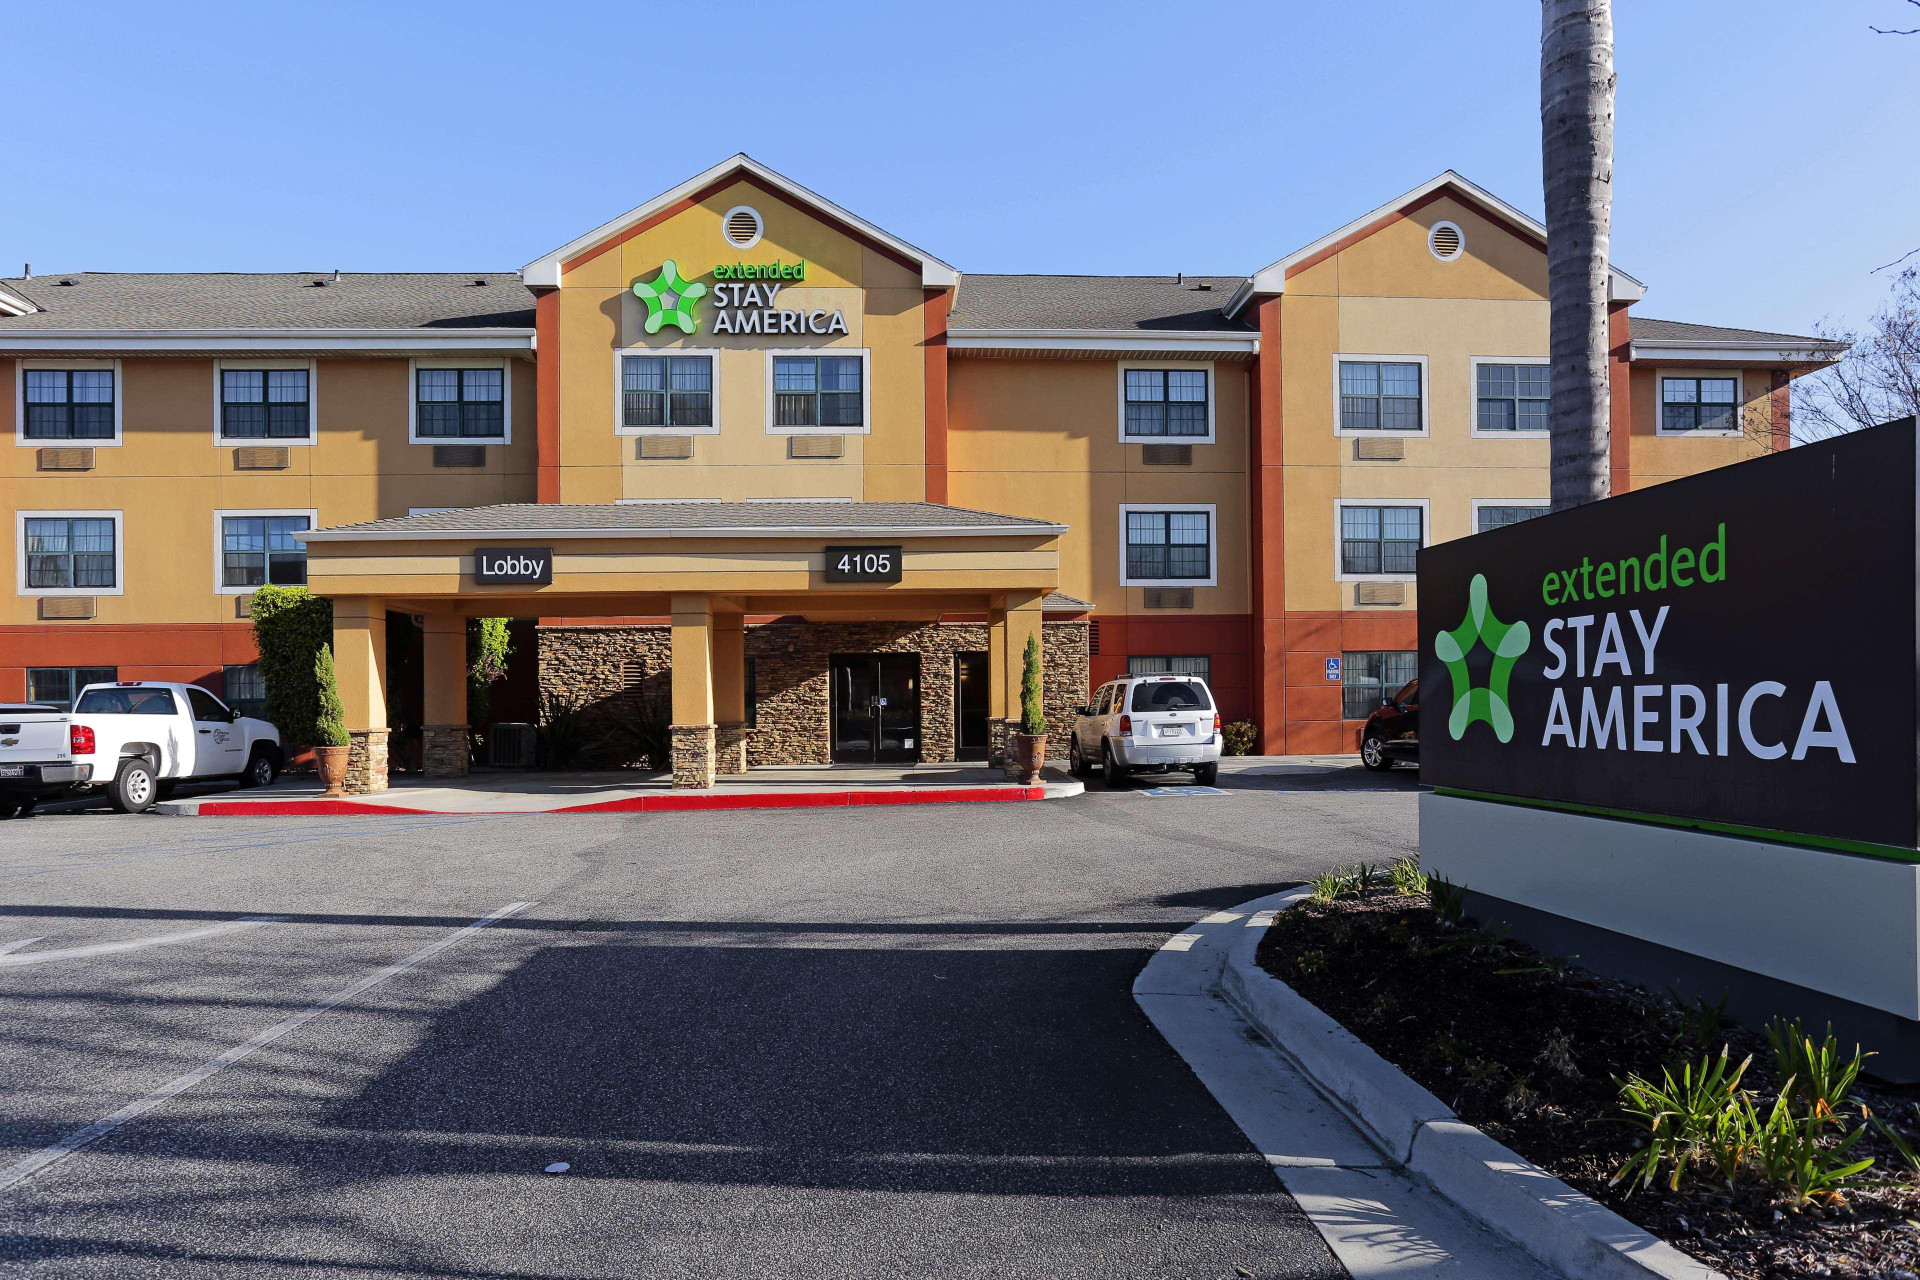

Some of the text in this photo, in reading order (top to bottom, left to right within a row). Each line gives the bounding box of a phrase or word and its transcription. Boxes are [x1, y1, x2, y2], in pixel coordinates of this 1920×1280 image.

[713, 259, 805, 280] extended
[713, 283, 782, 307] STAY
[712, 309, 849, 334] AMERICA
[482, 555, 545, 579] Lobby
[837, 553, 891, 574] 4105
[1542, 522, 1726, 606] extended
[1542, 605, 1671, 680] STAY
[1541, 680, 1857, 764] AMERICA
